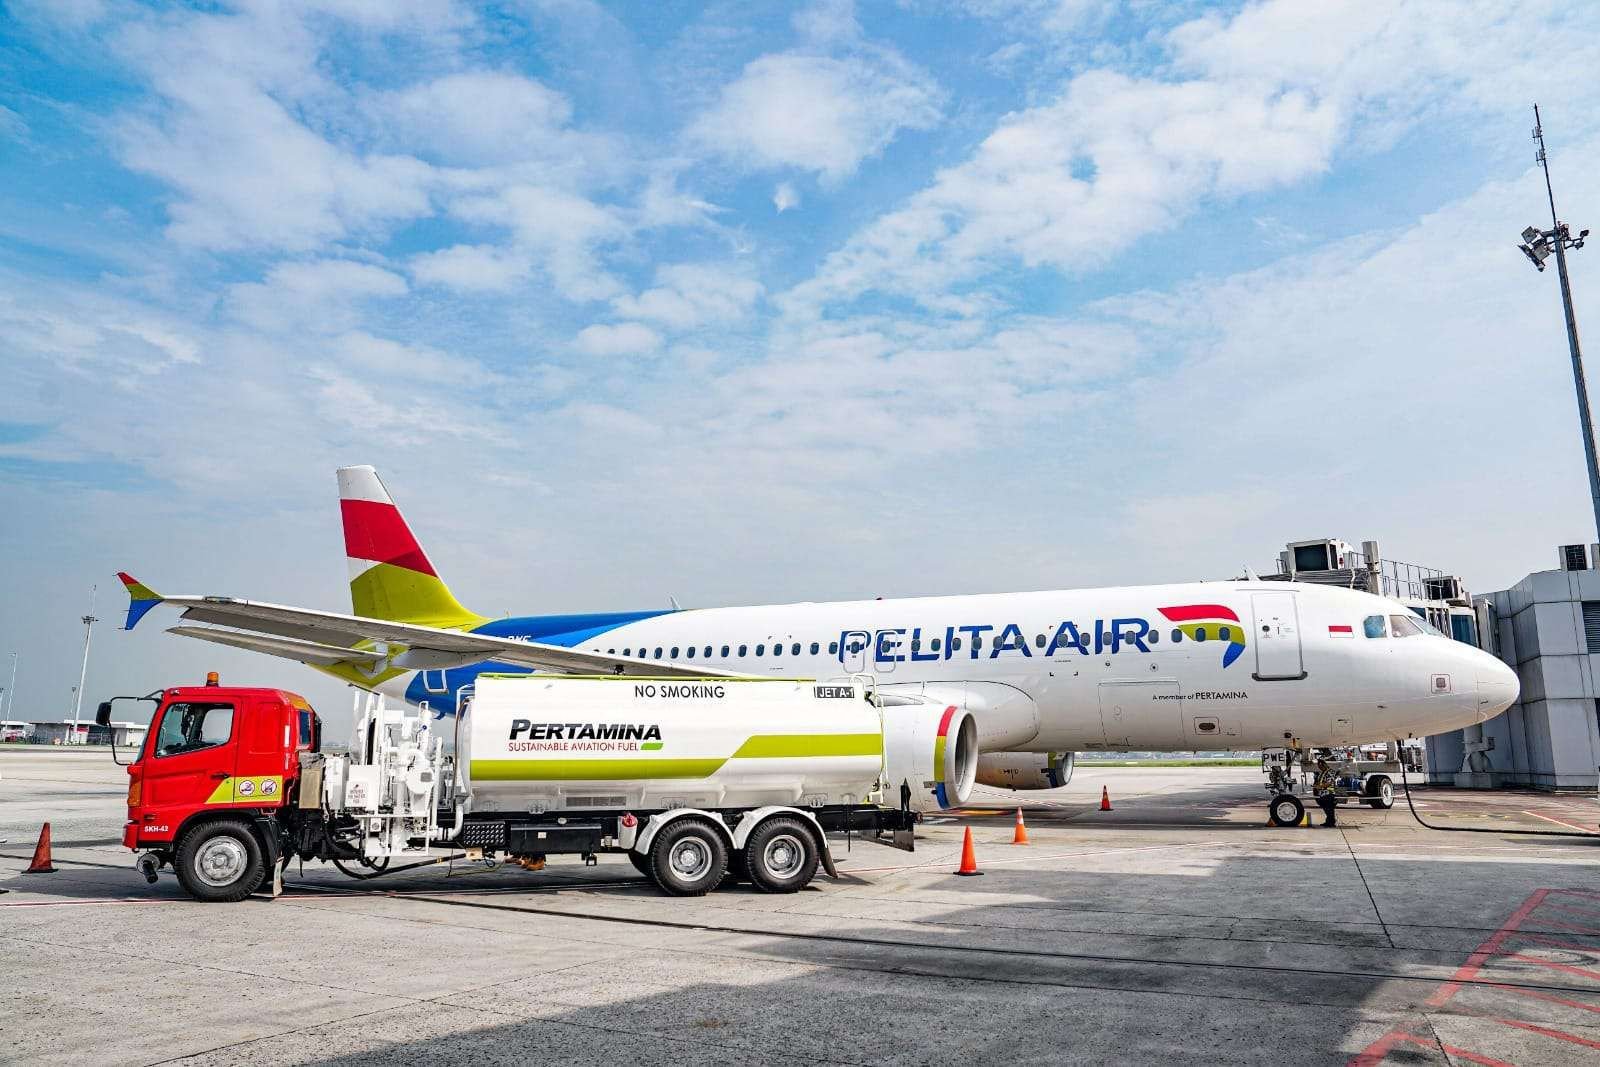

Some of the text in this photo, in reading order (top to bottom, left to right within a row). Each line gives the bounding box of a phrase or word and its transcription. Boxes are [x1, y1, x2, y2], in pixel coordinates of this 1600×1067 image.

[838, 617, 1152, 663] PELITA AIR
[635, 685, 725, 698] NO SMOKING
[819, 687, 854, 698] JET A-1
[1195, 691, 1248, 700] PERTAMINA
[509, 719, 661, 740] PERTAMINA
[508, 742, 639, 751] SUSTAINABLE AVIATION FUEL
[1262, 752, 1285, 762] PWE
